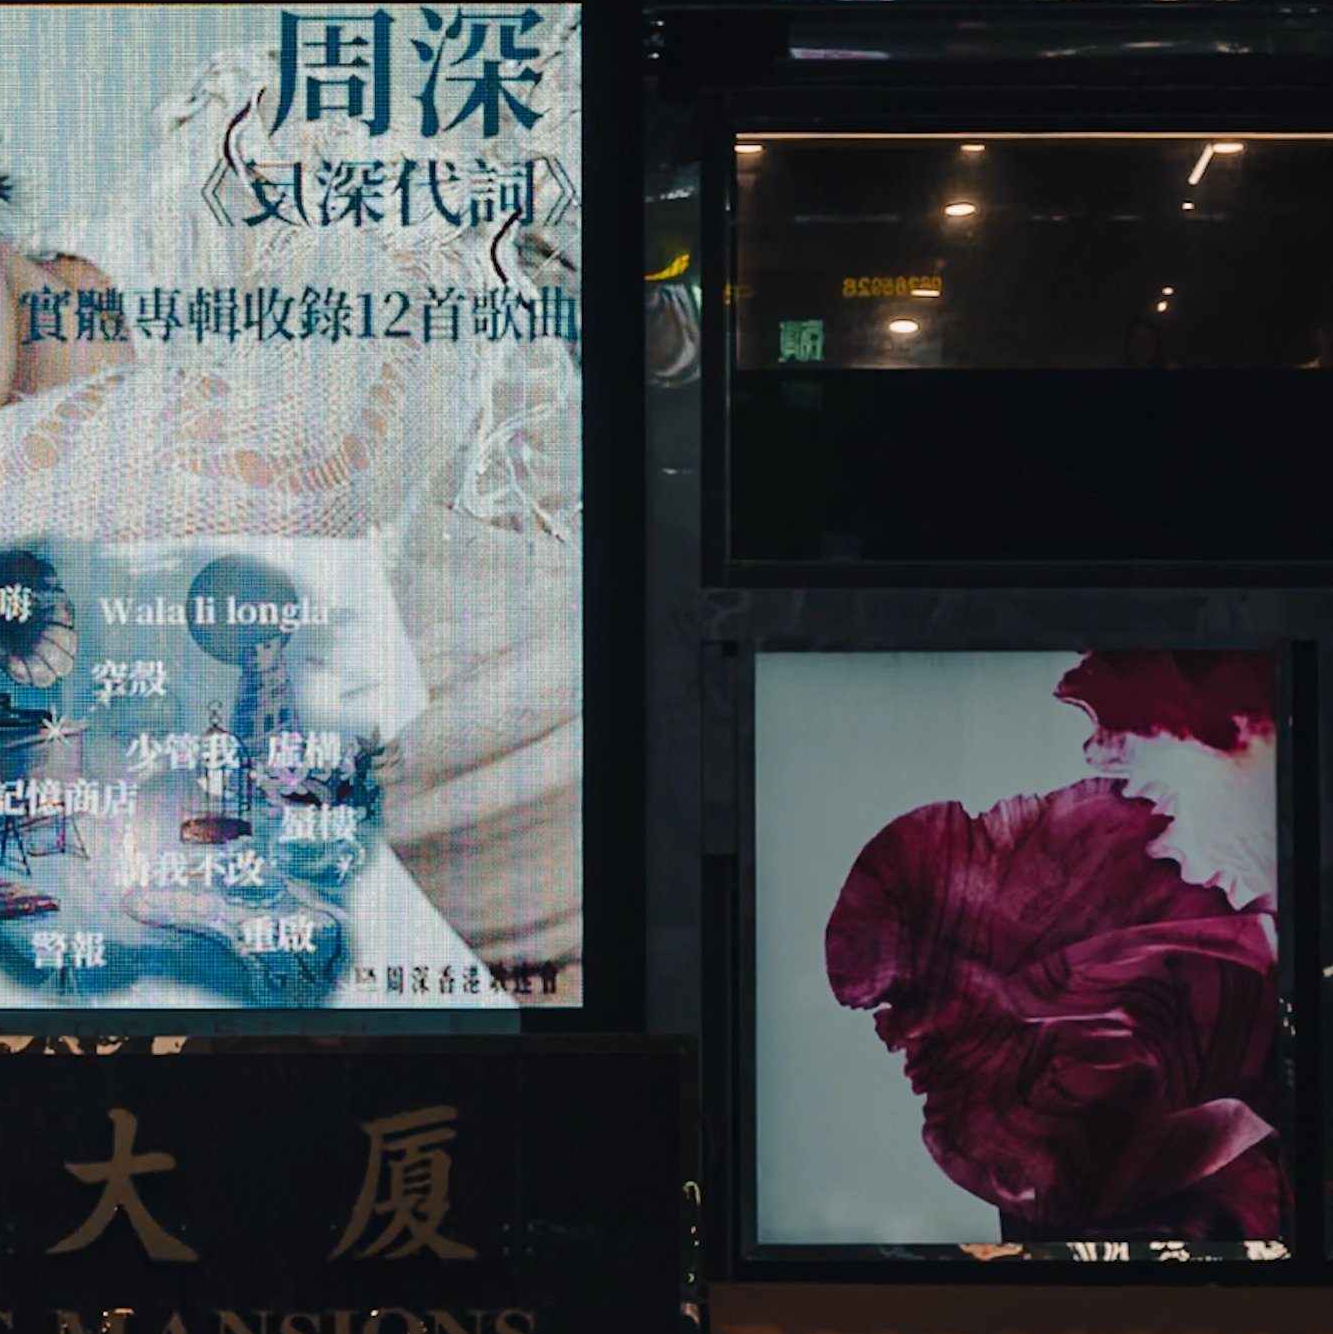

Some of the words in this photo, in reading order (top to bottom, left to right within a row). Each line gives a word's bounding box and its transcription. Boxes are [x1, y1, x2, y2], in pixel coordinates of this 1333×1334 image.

[268, 7, 546, 139] 周深
[19, 284, 578, 345] 實體專輯收錄12首歌曲
[100, 596, 185, 627] Wala
[194, 595, 217, 626] li
[226, 595, 328, 634] longla
[125, 731, 241, 772] 少管我
[32, 931, 108, 970] 警報
